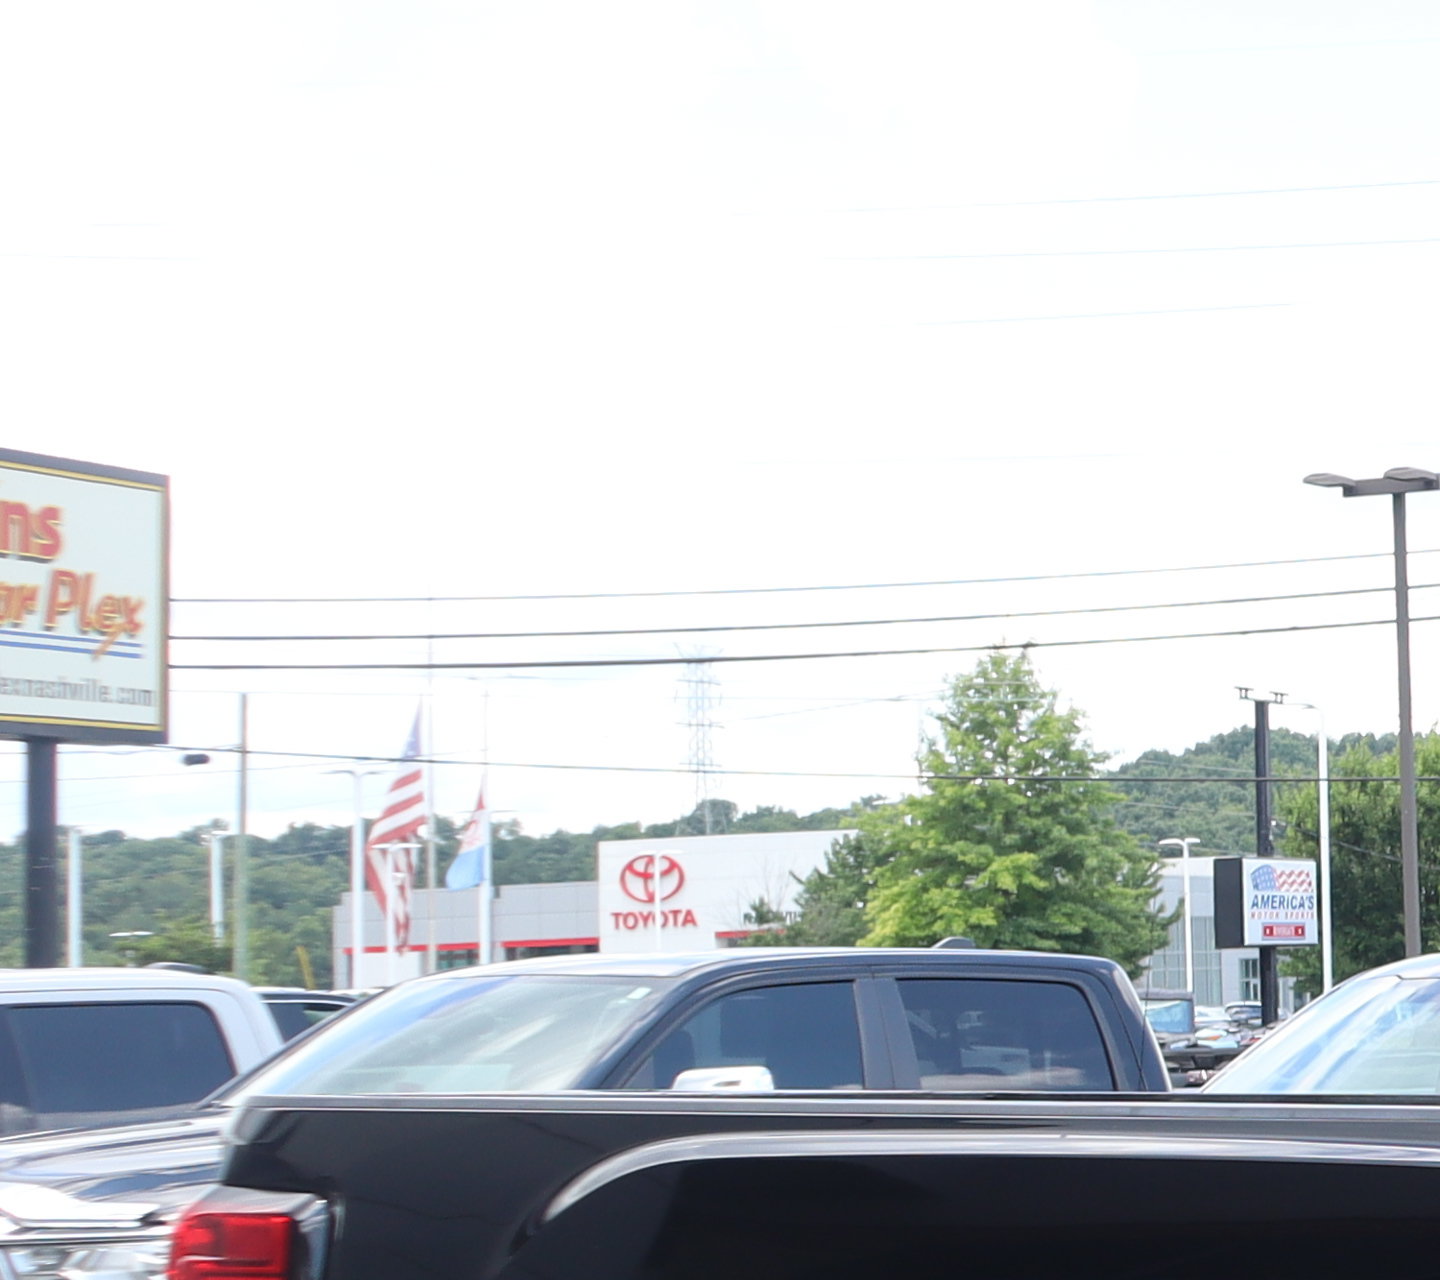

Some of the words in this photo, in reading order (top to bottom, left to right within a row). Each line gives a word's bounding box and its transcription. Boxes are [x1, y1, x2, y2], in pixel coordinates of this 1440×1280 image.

[44, 569, 144, 642] Plex
[1251, 894, 1314, 910] AMERICA'S
[611, 910, 698, 930] TOYOTA
